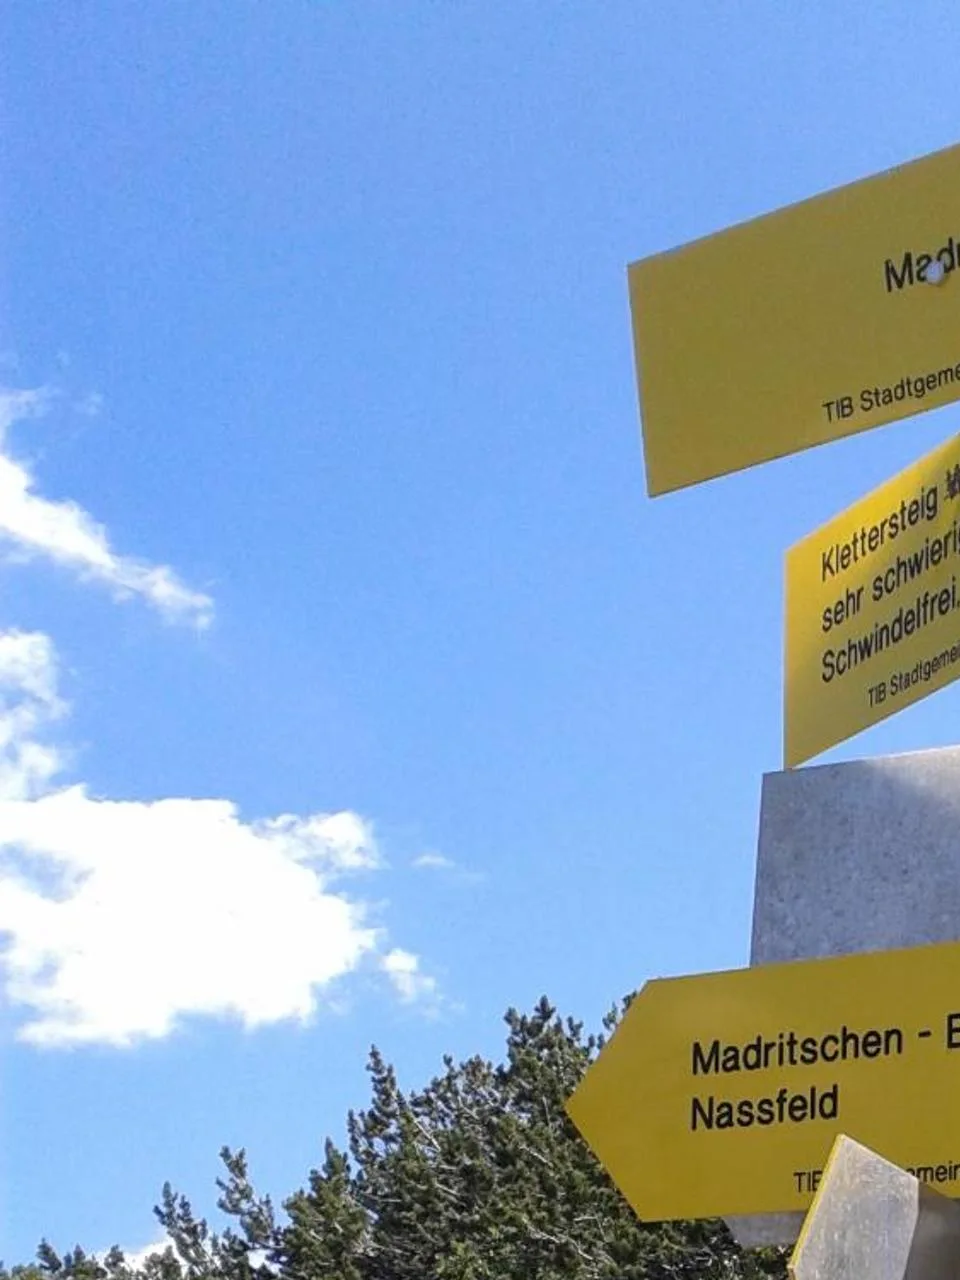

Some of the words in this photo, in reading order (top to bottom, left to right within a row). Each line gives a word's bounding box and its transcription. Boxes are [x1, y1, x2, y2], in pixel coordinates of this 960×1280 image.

[822, 397, 853, 424] TIB
[822, 486, 938, 581] Klettersteig
[822, 582, 864, 632] sehr
[867, 684, 888, 708] TIB
[691, 1024, 903, 1076] Madritschen
[690, 1085, 839, 1130] Nassfeld
